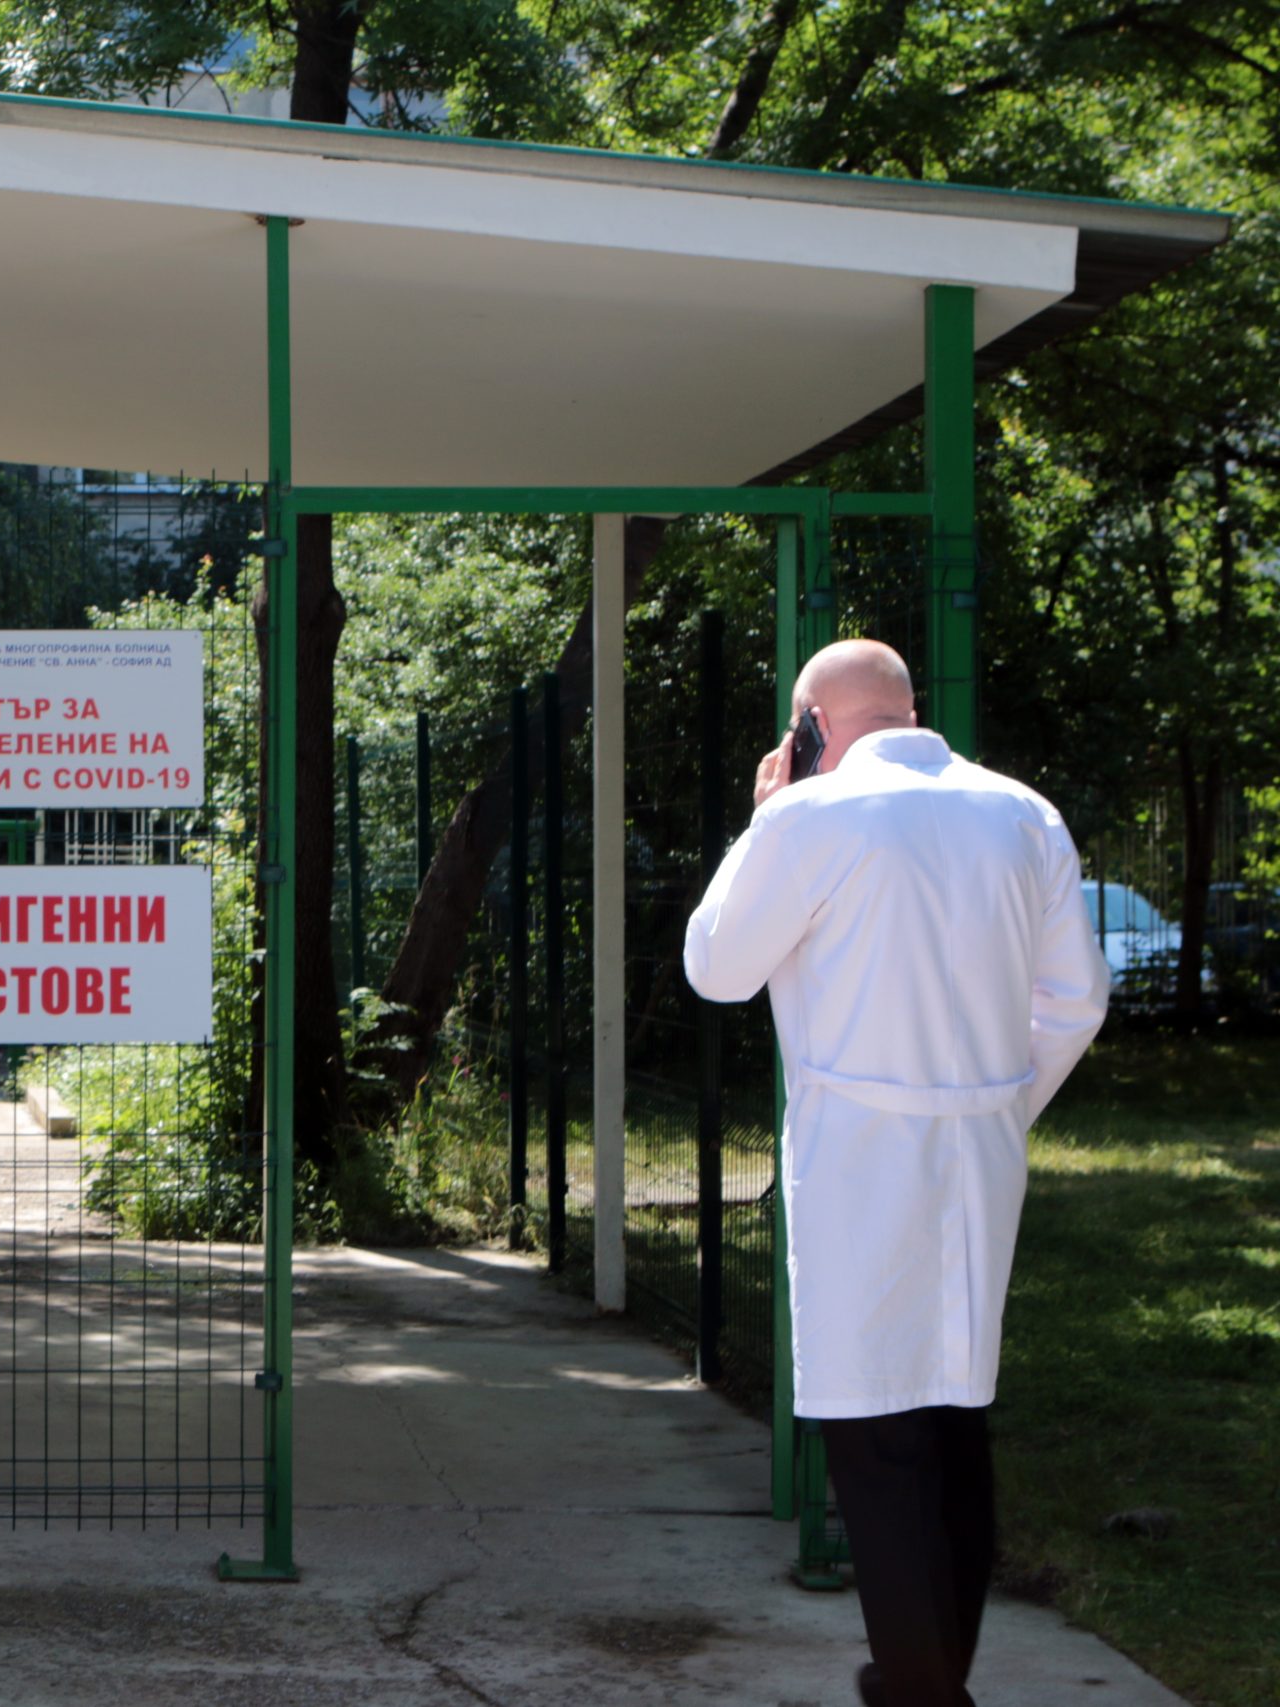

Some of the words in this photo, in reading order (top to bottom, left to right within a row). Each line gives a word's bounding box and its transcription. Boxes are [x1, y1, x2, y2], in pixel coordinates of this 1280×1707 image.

[5, 643, 111, 654] МНОГОПРОФИЛНА
[115, 643, 171, 655] БОЛНИЦА
[111, 657, 150, 667] СОФИЯ
[154, 657, 172, 668] АД
[62, 698, 100, 720] ЗА
[129, 732, 170, 754] НА
[23, 767, 42, 790] С
[53, 767, 190, 790] COVID-19
